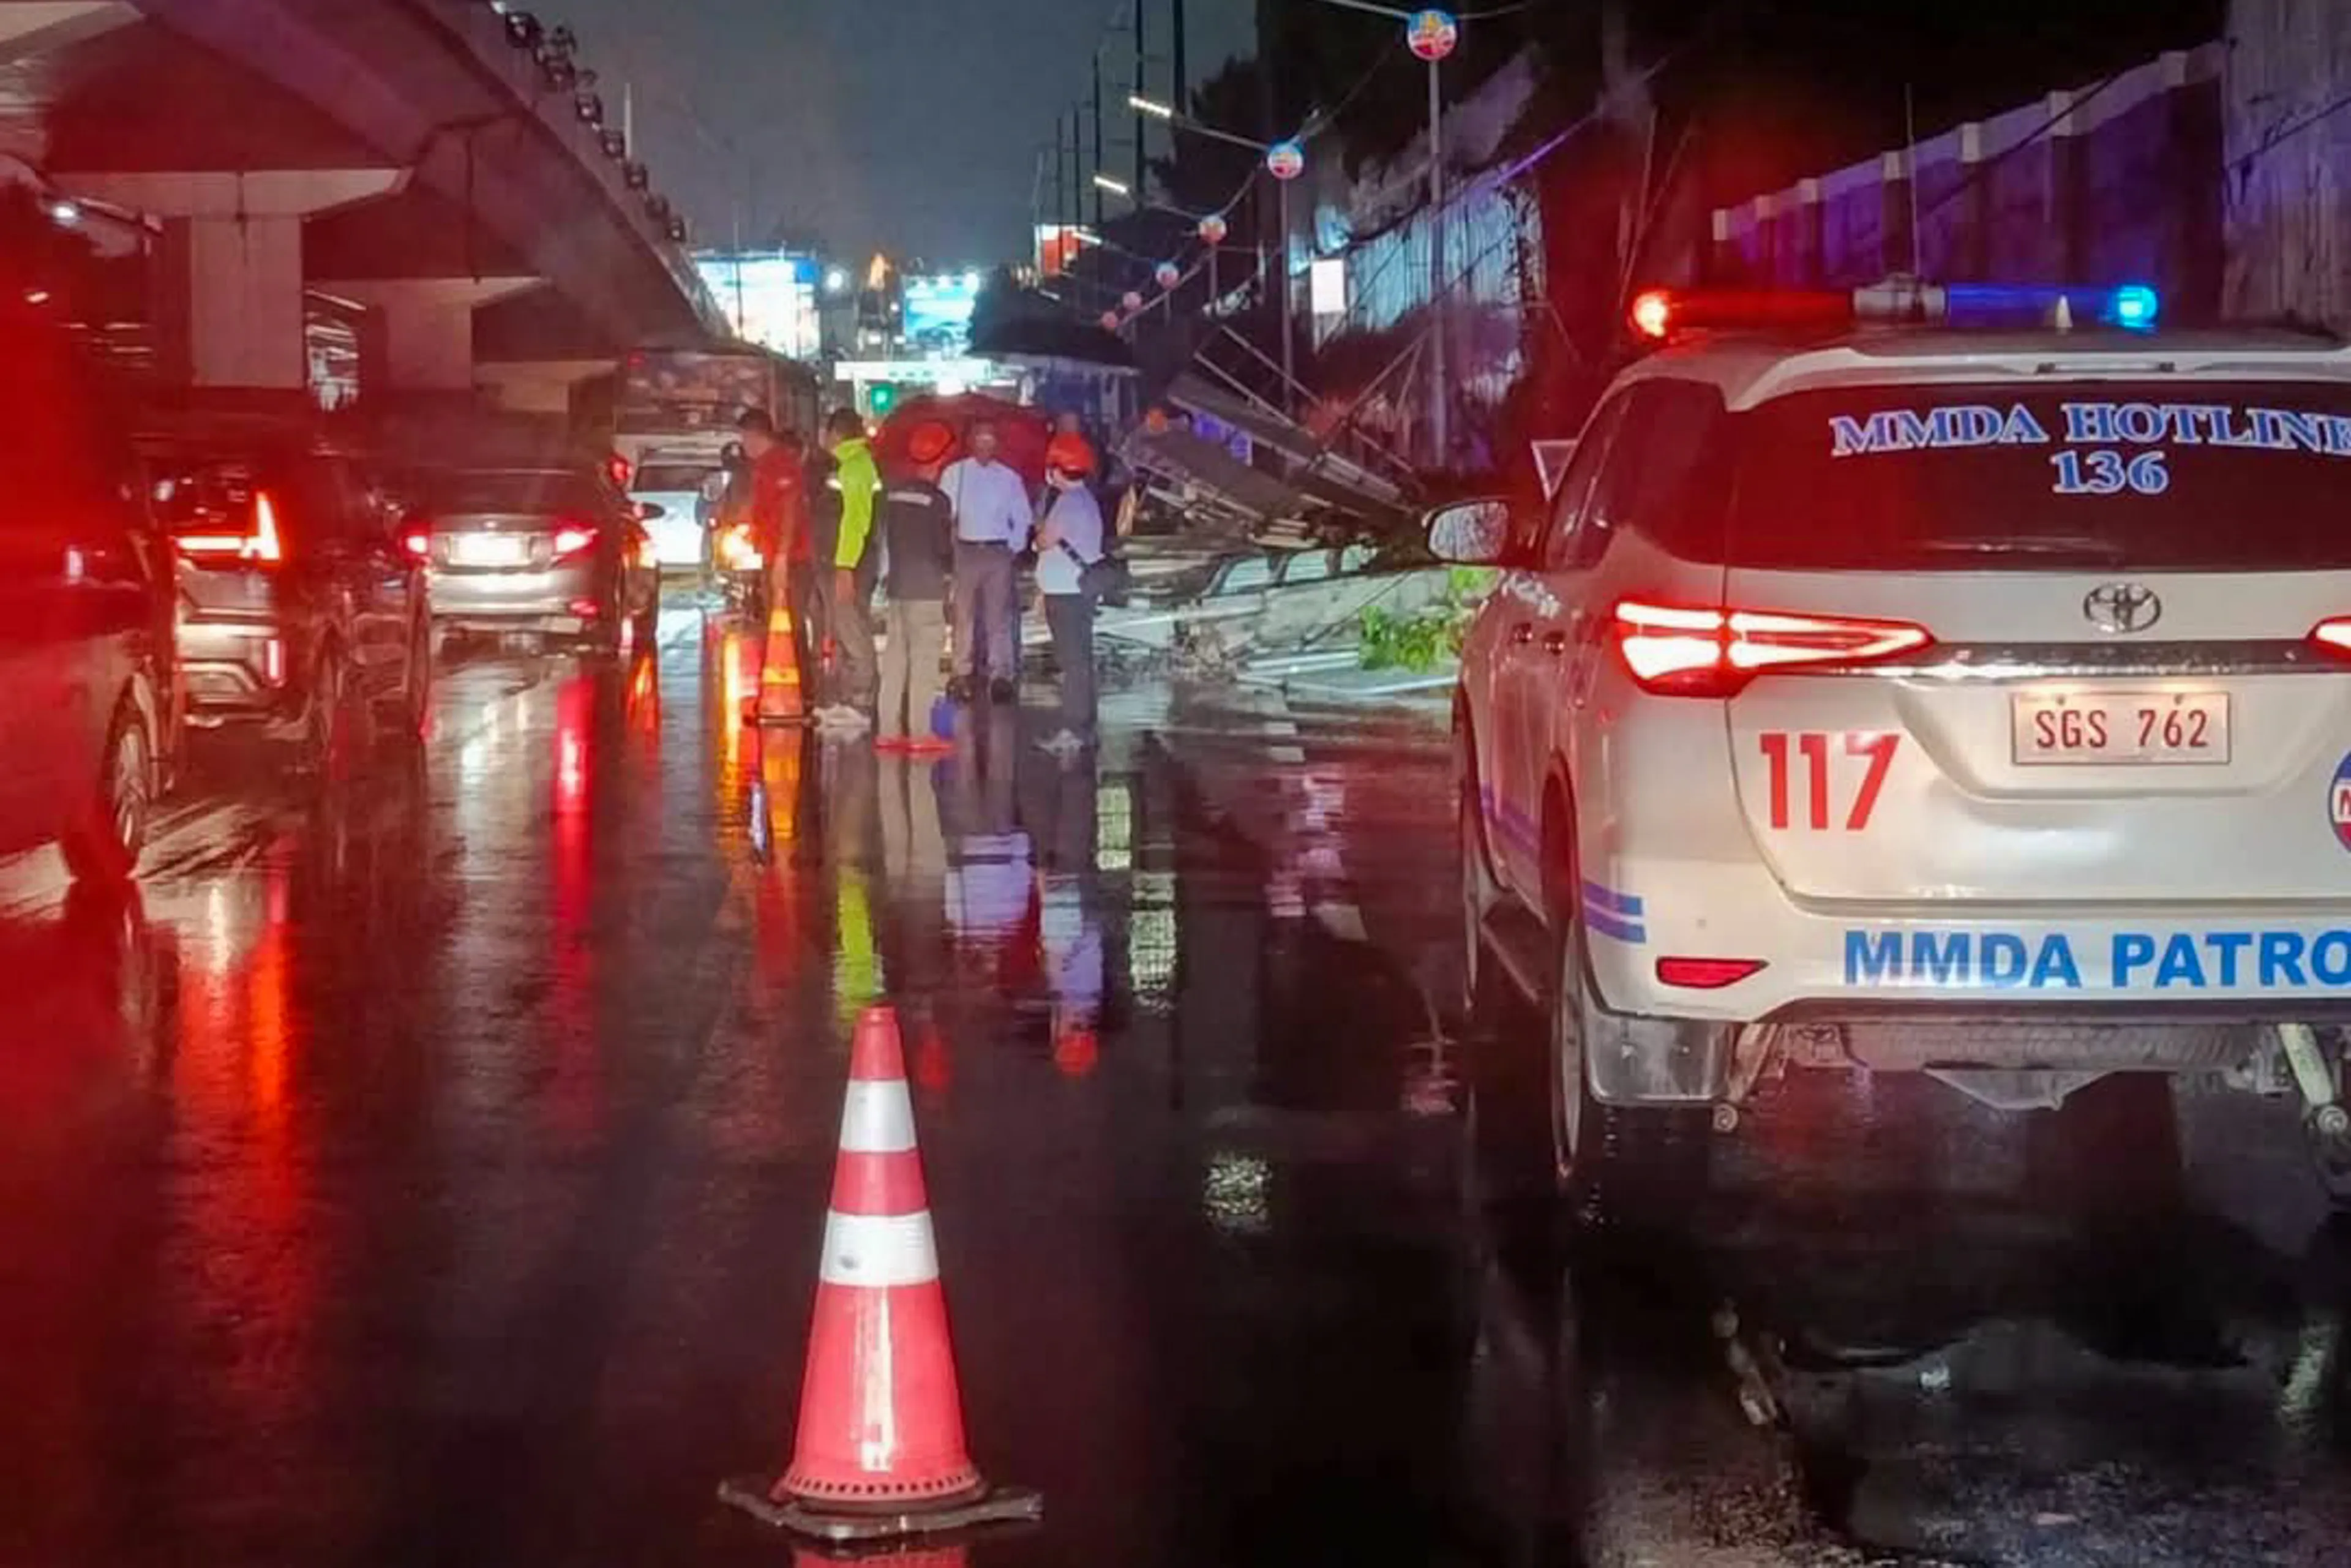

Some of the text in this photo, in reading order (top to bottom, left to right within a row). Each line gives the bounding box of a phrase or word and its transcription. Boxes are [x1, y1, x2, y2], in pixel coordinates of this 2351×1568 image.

[1829, 403, 2049, 456] MMDA
[2050, 450, 2170, 493] 136
[2036, 710, 2209, 748] SGS 762
[1760, 733, 1900, 830] 117
[1845, 930, 2351, 988] MMDA PATRO
